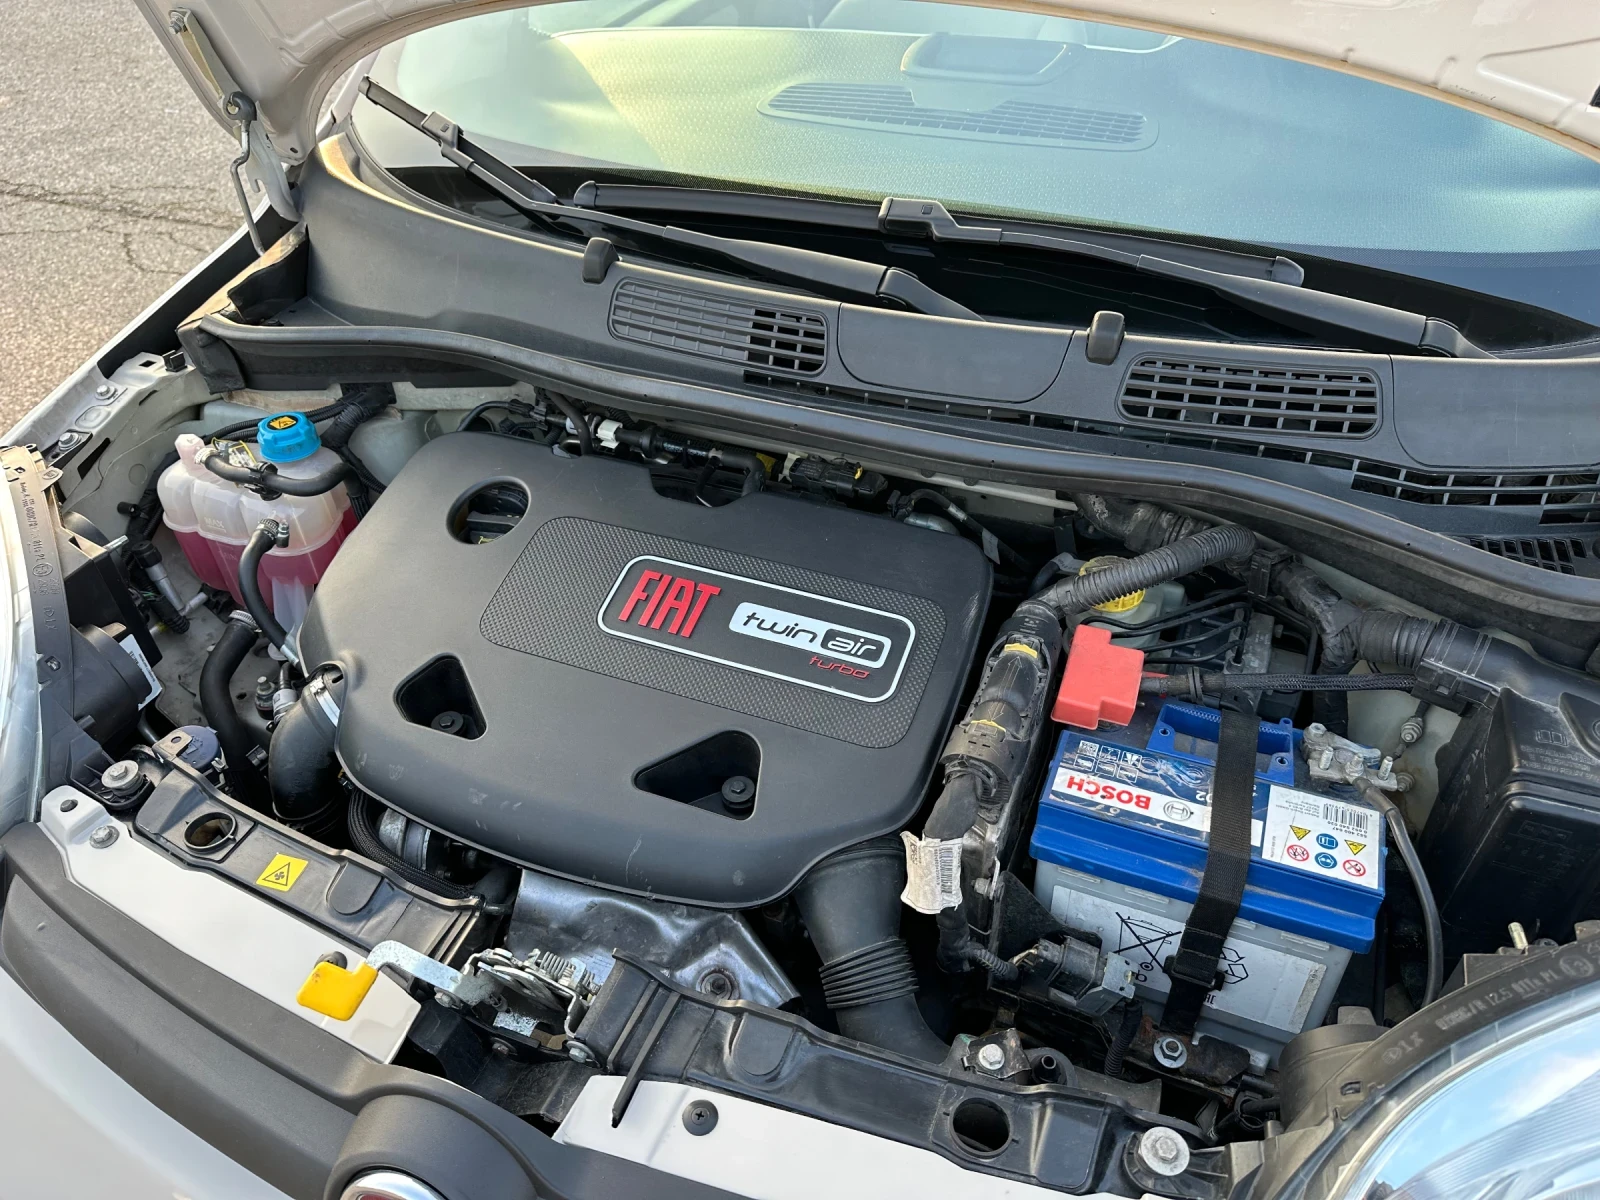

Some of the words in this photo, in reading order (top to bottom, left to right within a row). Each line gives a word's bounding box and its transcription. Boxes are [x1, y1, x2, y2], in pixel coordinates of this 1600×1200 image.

[204, 517, 225, 529] MAX
[618, 569, 721, 638] FIAT
[743, 612, 818, 643] twin
[827, 637, 877, 656] air
[809, 655, 871, 679] turbo
[1066, 775, 1152, 811] BOSCH
